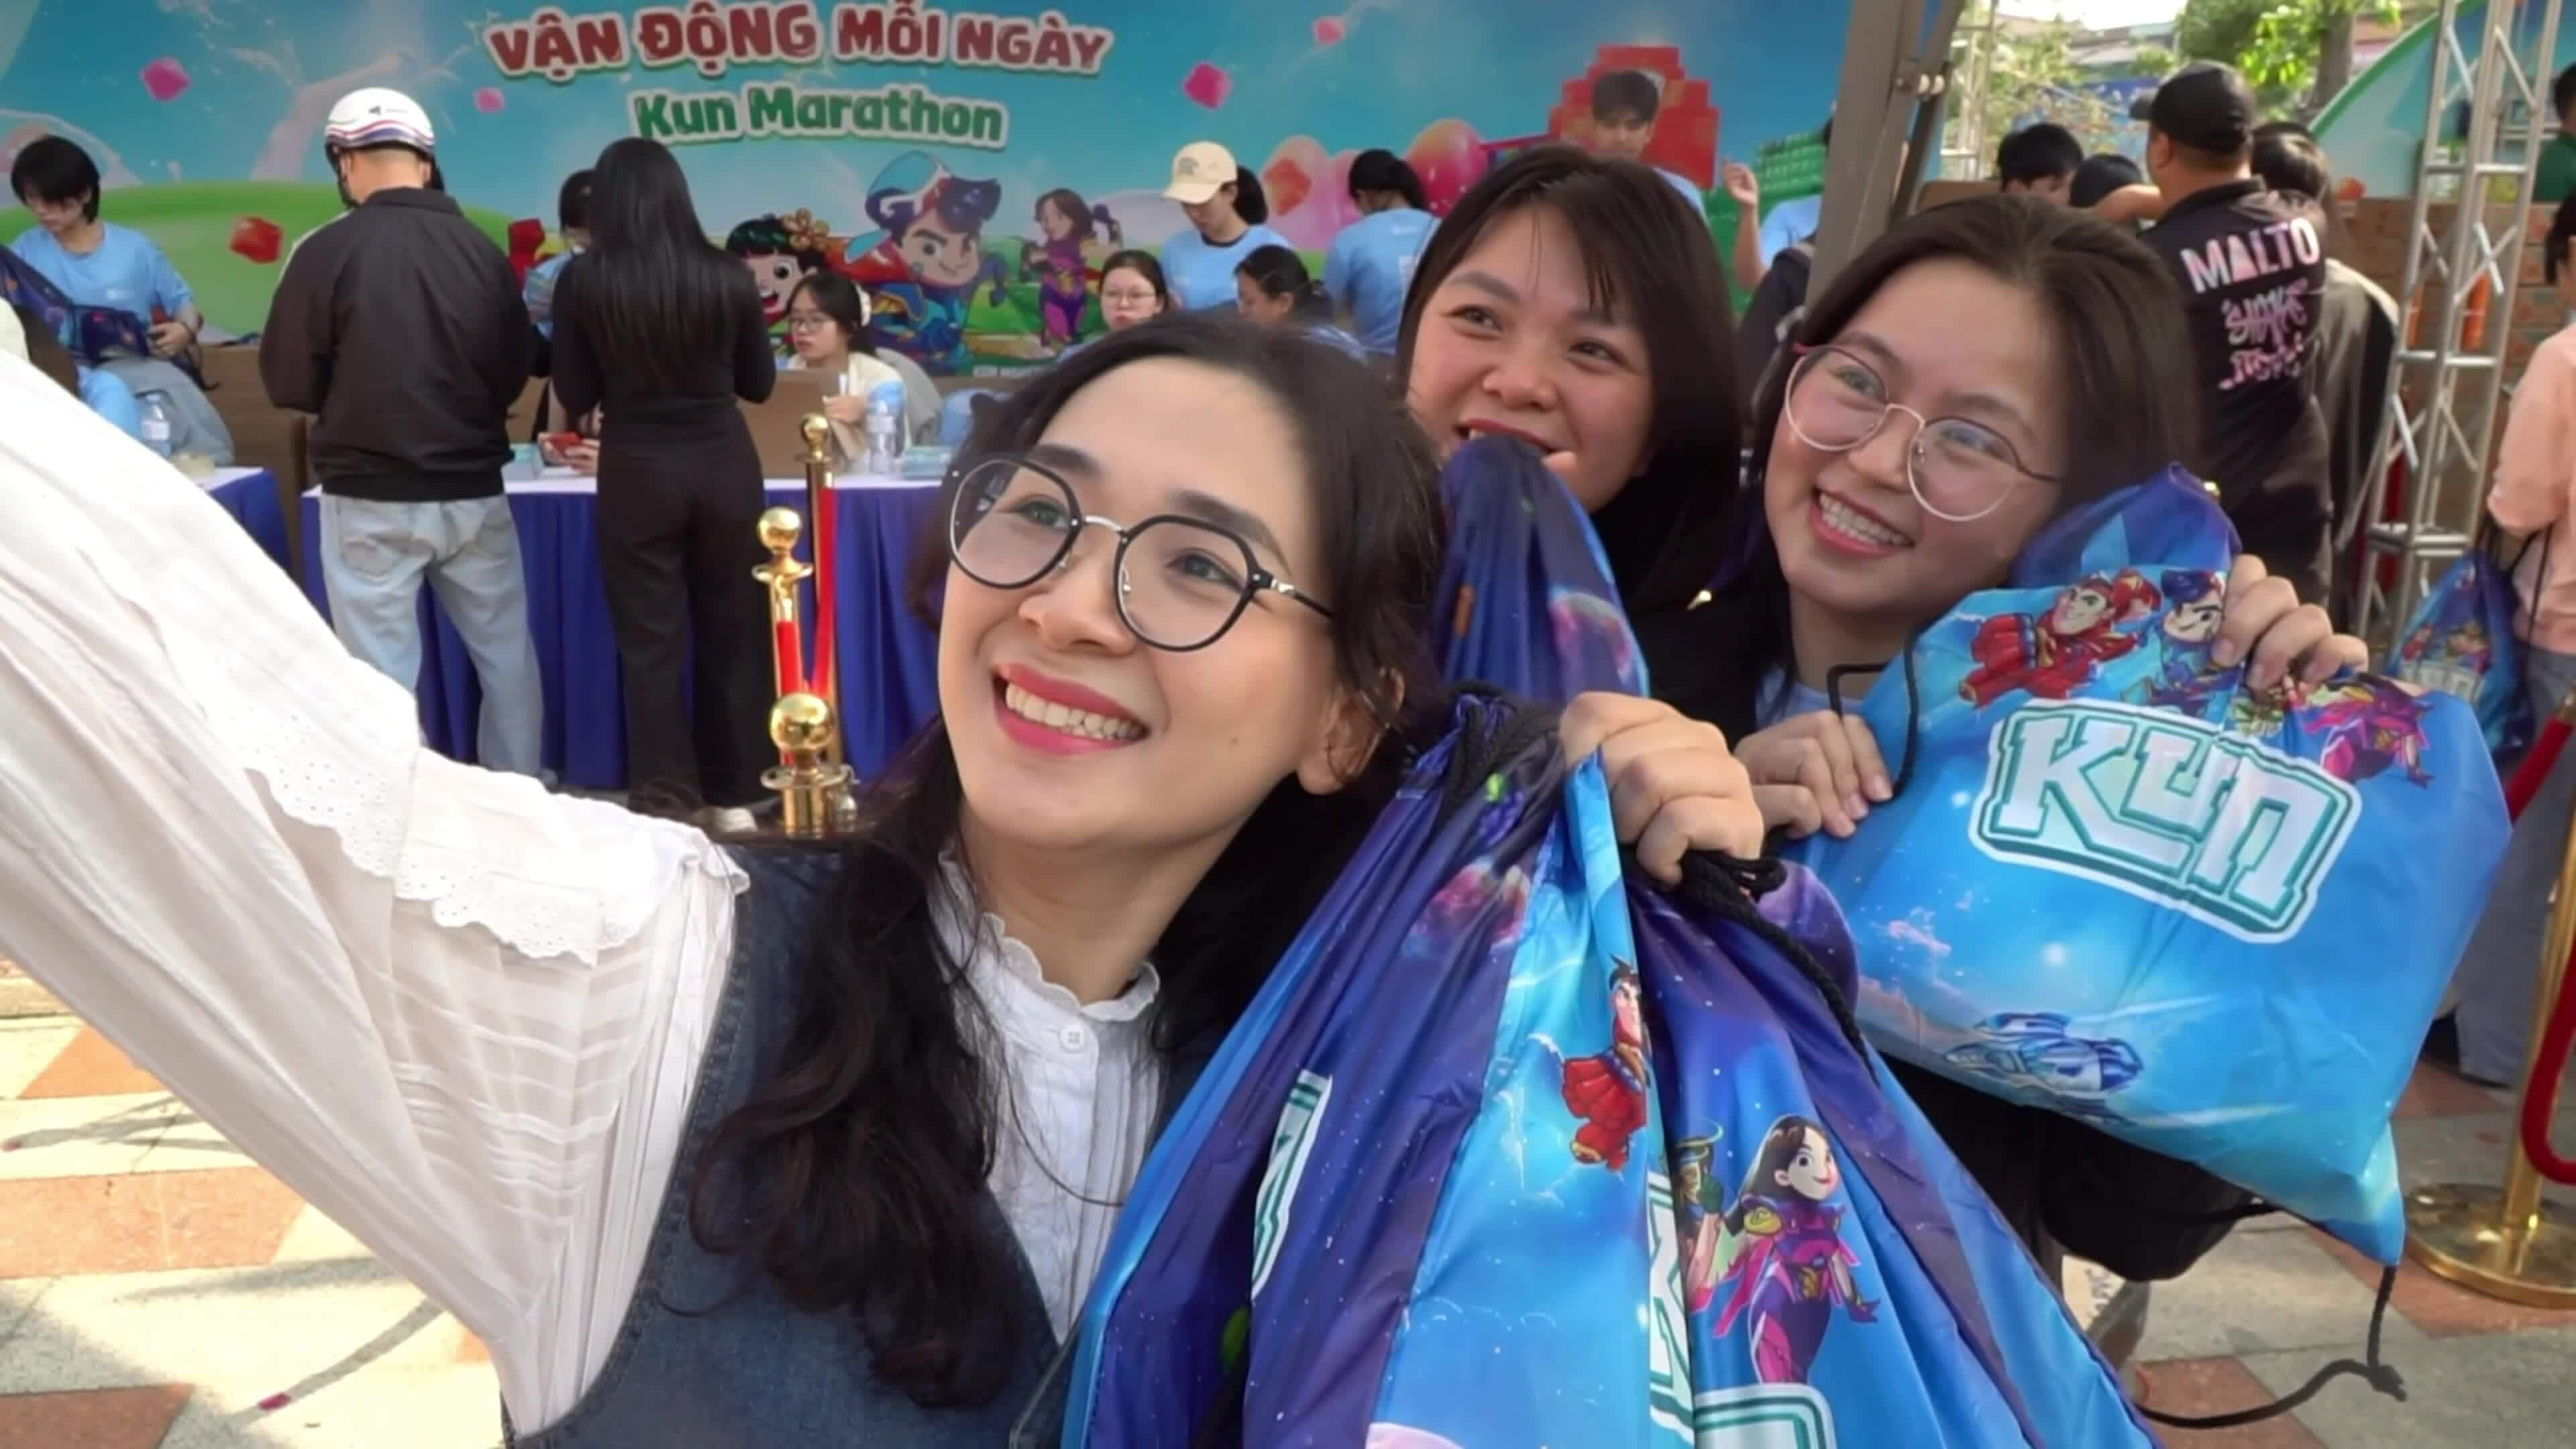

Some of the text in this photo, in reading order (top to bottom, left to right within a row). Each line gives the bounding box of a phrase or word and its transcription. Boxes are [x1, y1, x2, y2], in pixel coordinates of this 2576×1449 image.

[490, 0, 1106, 77] VẬN ĐỘNG MỖI NGÀY
[634, 87, 1003, 142] Kun Marathon
[2180, 218, 2320, 293] MALTO
